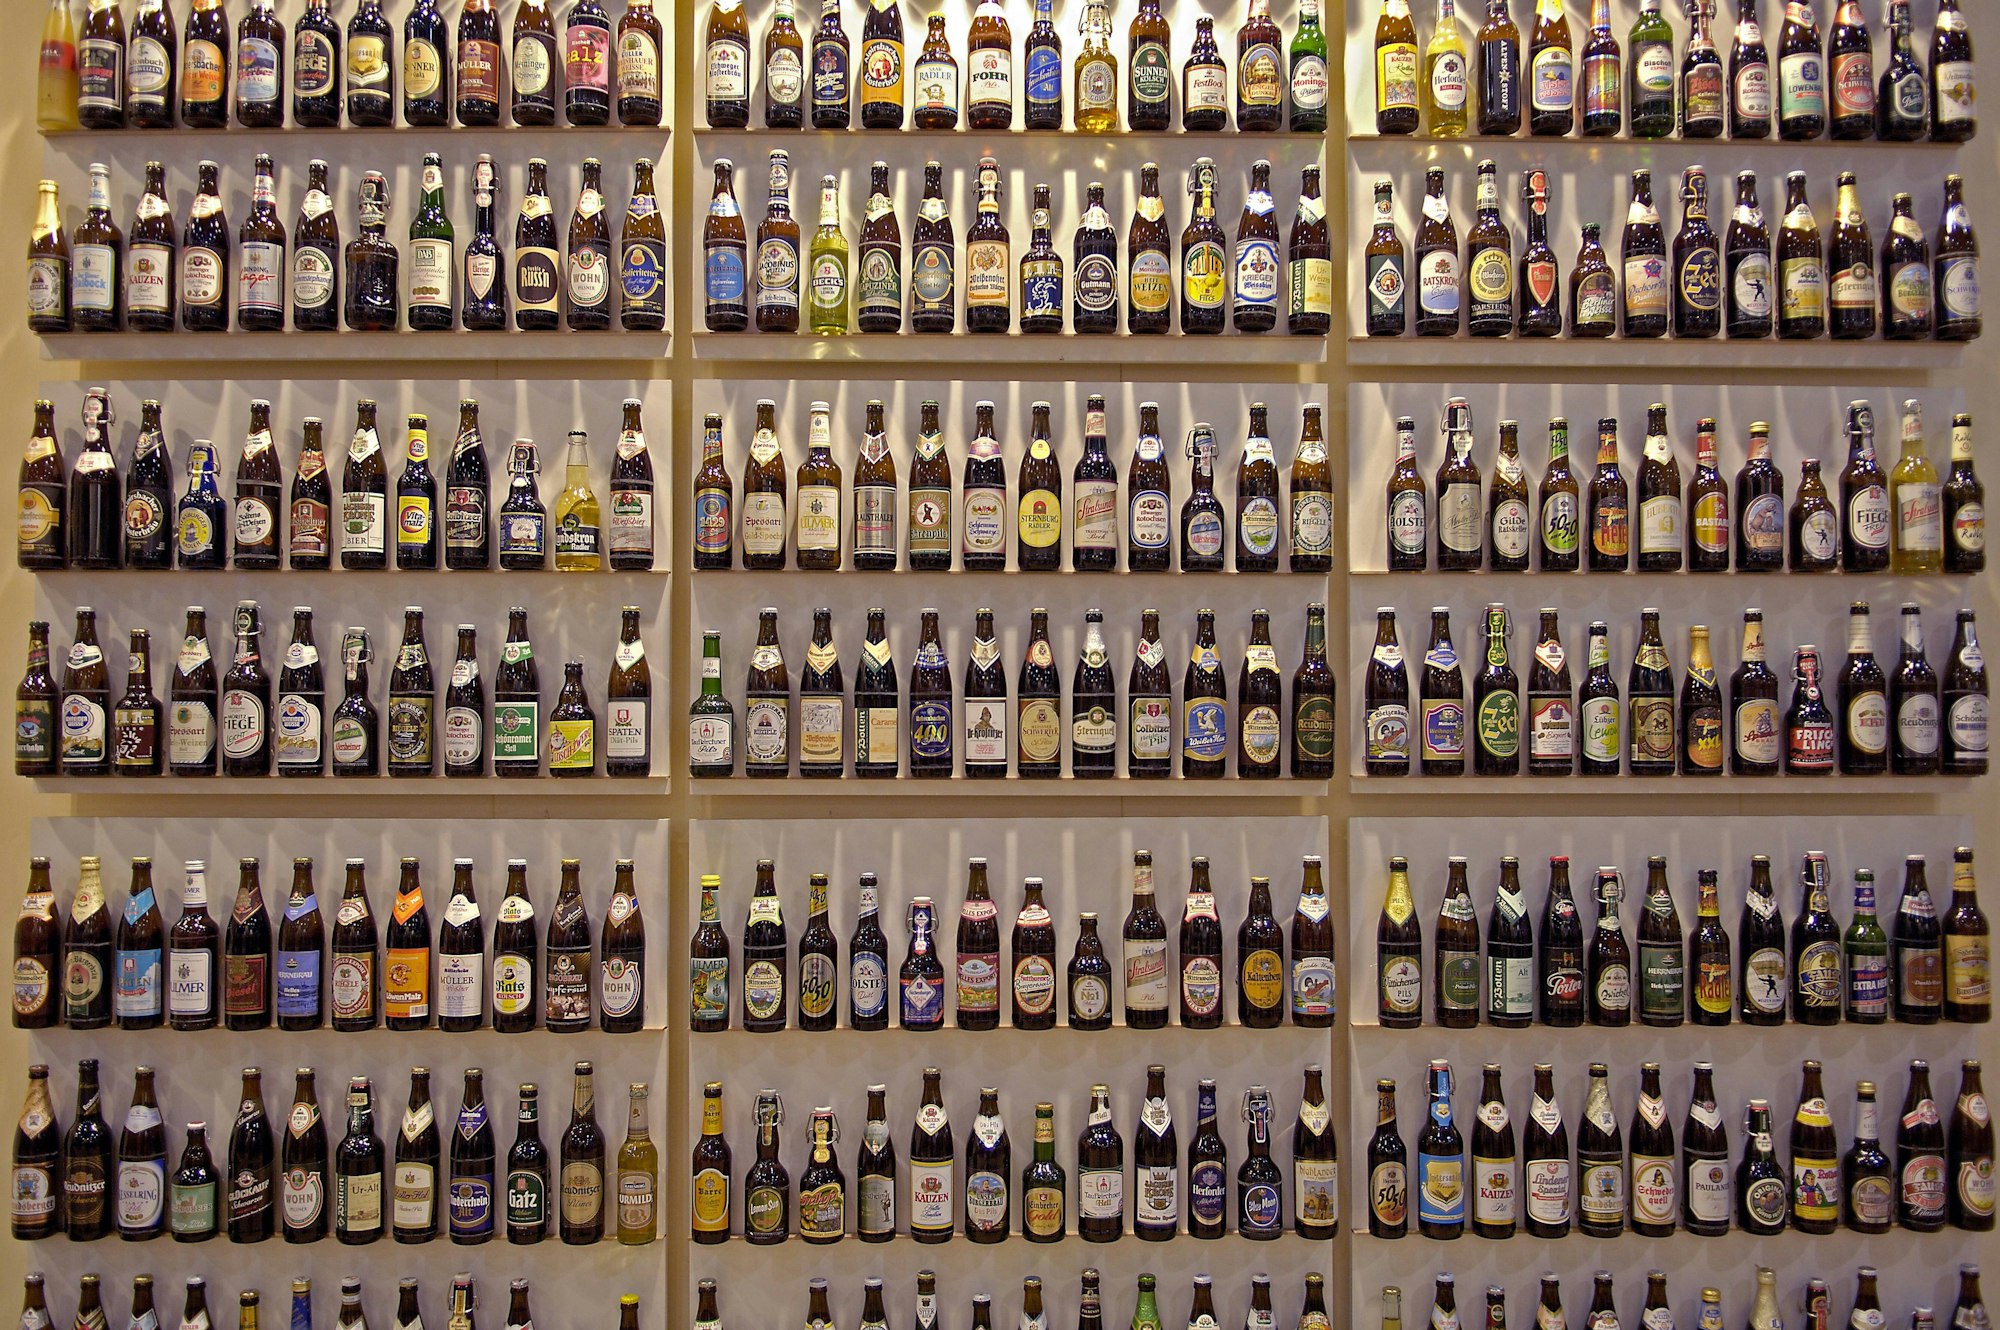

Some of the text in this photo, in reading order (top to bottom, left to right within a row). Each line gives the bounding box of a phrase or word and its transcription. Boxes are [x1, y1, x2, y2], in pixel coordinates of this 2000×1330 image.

[1134, 65, 1169, 78] SÜNNER
[864, 73, 900, 90] Klosterbräu
[919, 71, 952, 85] RADLER
[972, 71, 1008, 86] FOHR
[1139, 74, 1165, 84] KÖLSCH
[417, 250, 433, 259] DAB
[760, 260, 794, 271] JACOBINUS
[129, 275, 163, 286] KAUZEN
[573, 273, 600, 284] WOHN
[1242, 274, 1273, 283] KRIEGER
[1081, 281, 1111, 289] Gutmann
[407, 511, 425, 519] Vita-
[1021, 513, 1059, 523] STERNBURG
[746, 515, 781, 527] Spessart
[800, 518, 835, 529] ULMER
[1028, 522, 1050, 530] RADLER
[1302, 517, 1326, 526] RIEGELE
[1500, 517, 1525, 526] Gilde
[1498, 525, 1527, 534] Ratskeller
[224, 715, 255, 730] FIEGE
[1594, 715, 1615, 724] Lübzer
[608, 727, 642, 736] SPATEN
[914, 724, 947, 745] 400
[697, 745, 718, 753] Pils
[693, 960, 724, 971] ULMER
[1518, 968, 1528, 977] Alt
[440, 975, 474, 986] MÜLLER
[495, 979, 525, 993] Rats
[1548, 973, 1582, 997] Porter
[1853, 980, 1876, 991] EXTRA
[604, 982, 631, 993] WOHN
[352, 1183, 379, 1195] Ur-Alt
[698, 1186, 722, 1196] Barre
[1192, 1184, 1226, 1196] Herforder
[1378, 1184, 1396, 1205] 50
[286, 1192, 313, 1204] WOHN
[508, 1188, 538, 1210] Gatz
[914, 1191, 949, 1203] KAUZEN
[1649, 1196, 1667, 1205] quell
